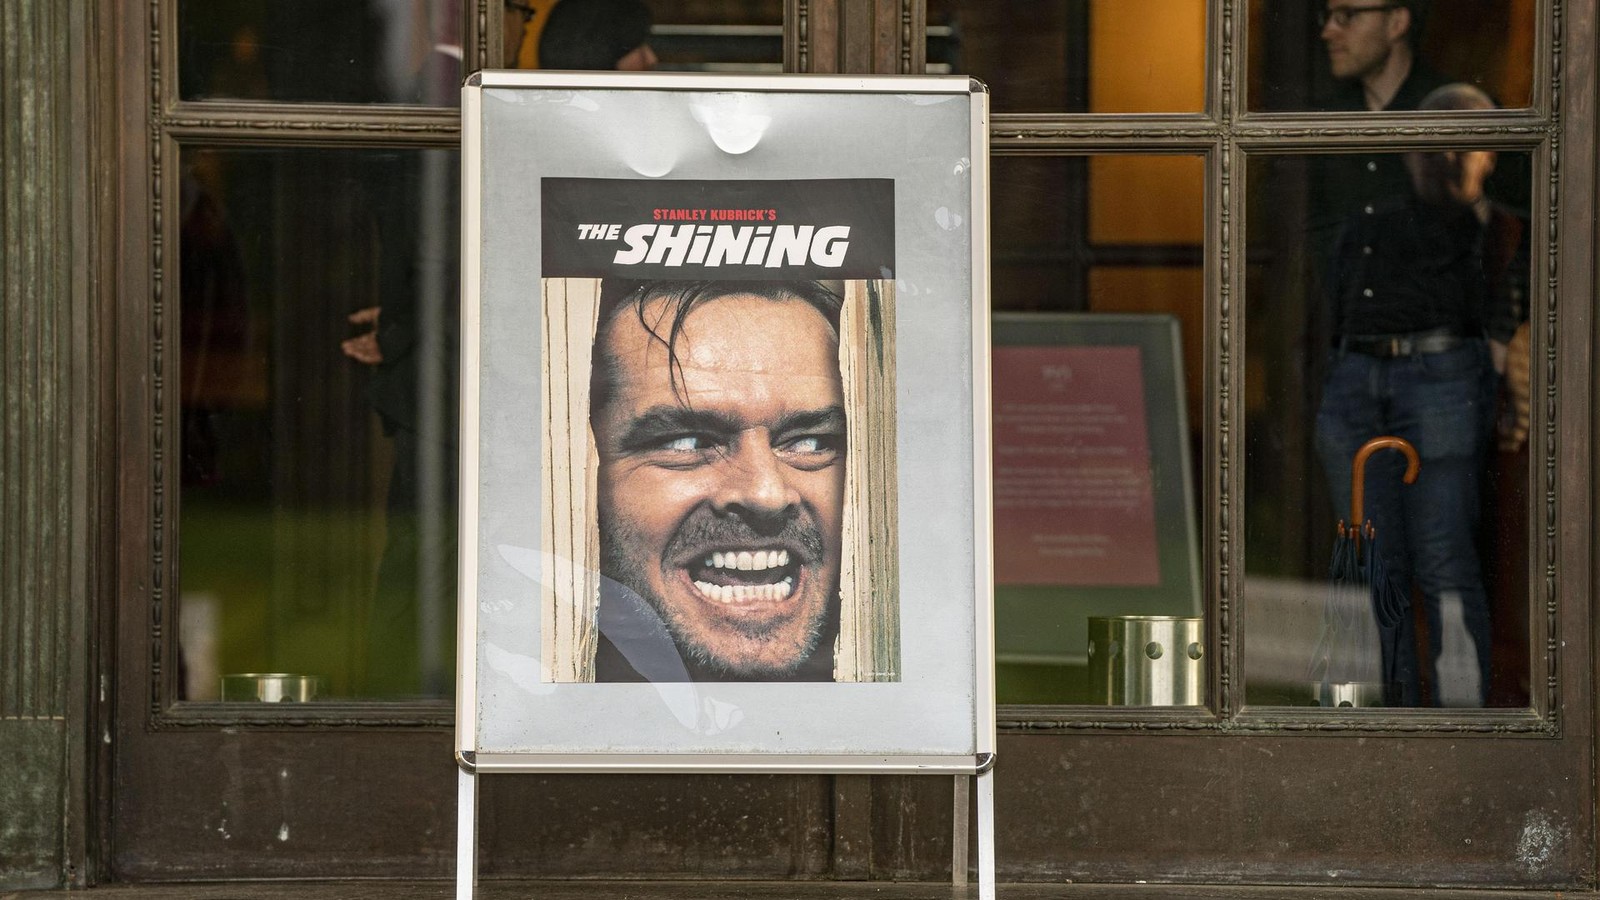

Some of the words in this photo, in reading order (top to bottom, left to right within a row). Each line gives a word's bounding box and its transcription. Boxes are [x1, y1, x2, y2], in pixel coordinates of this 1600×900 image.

[653, 209, 707, 220] STANLEY
[710, 209, 777, 221] KUBRICK'S
[577, 224, 623, 240] THE
